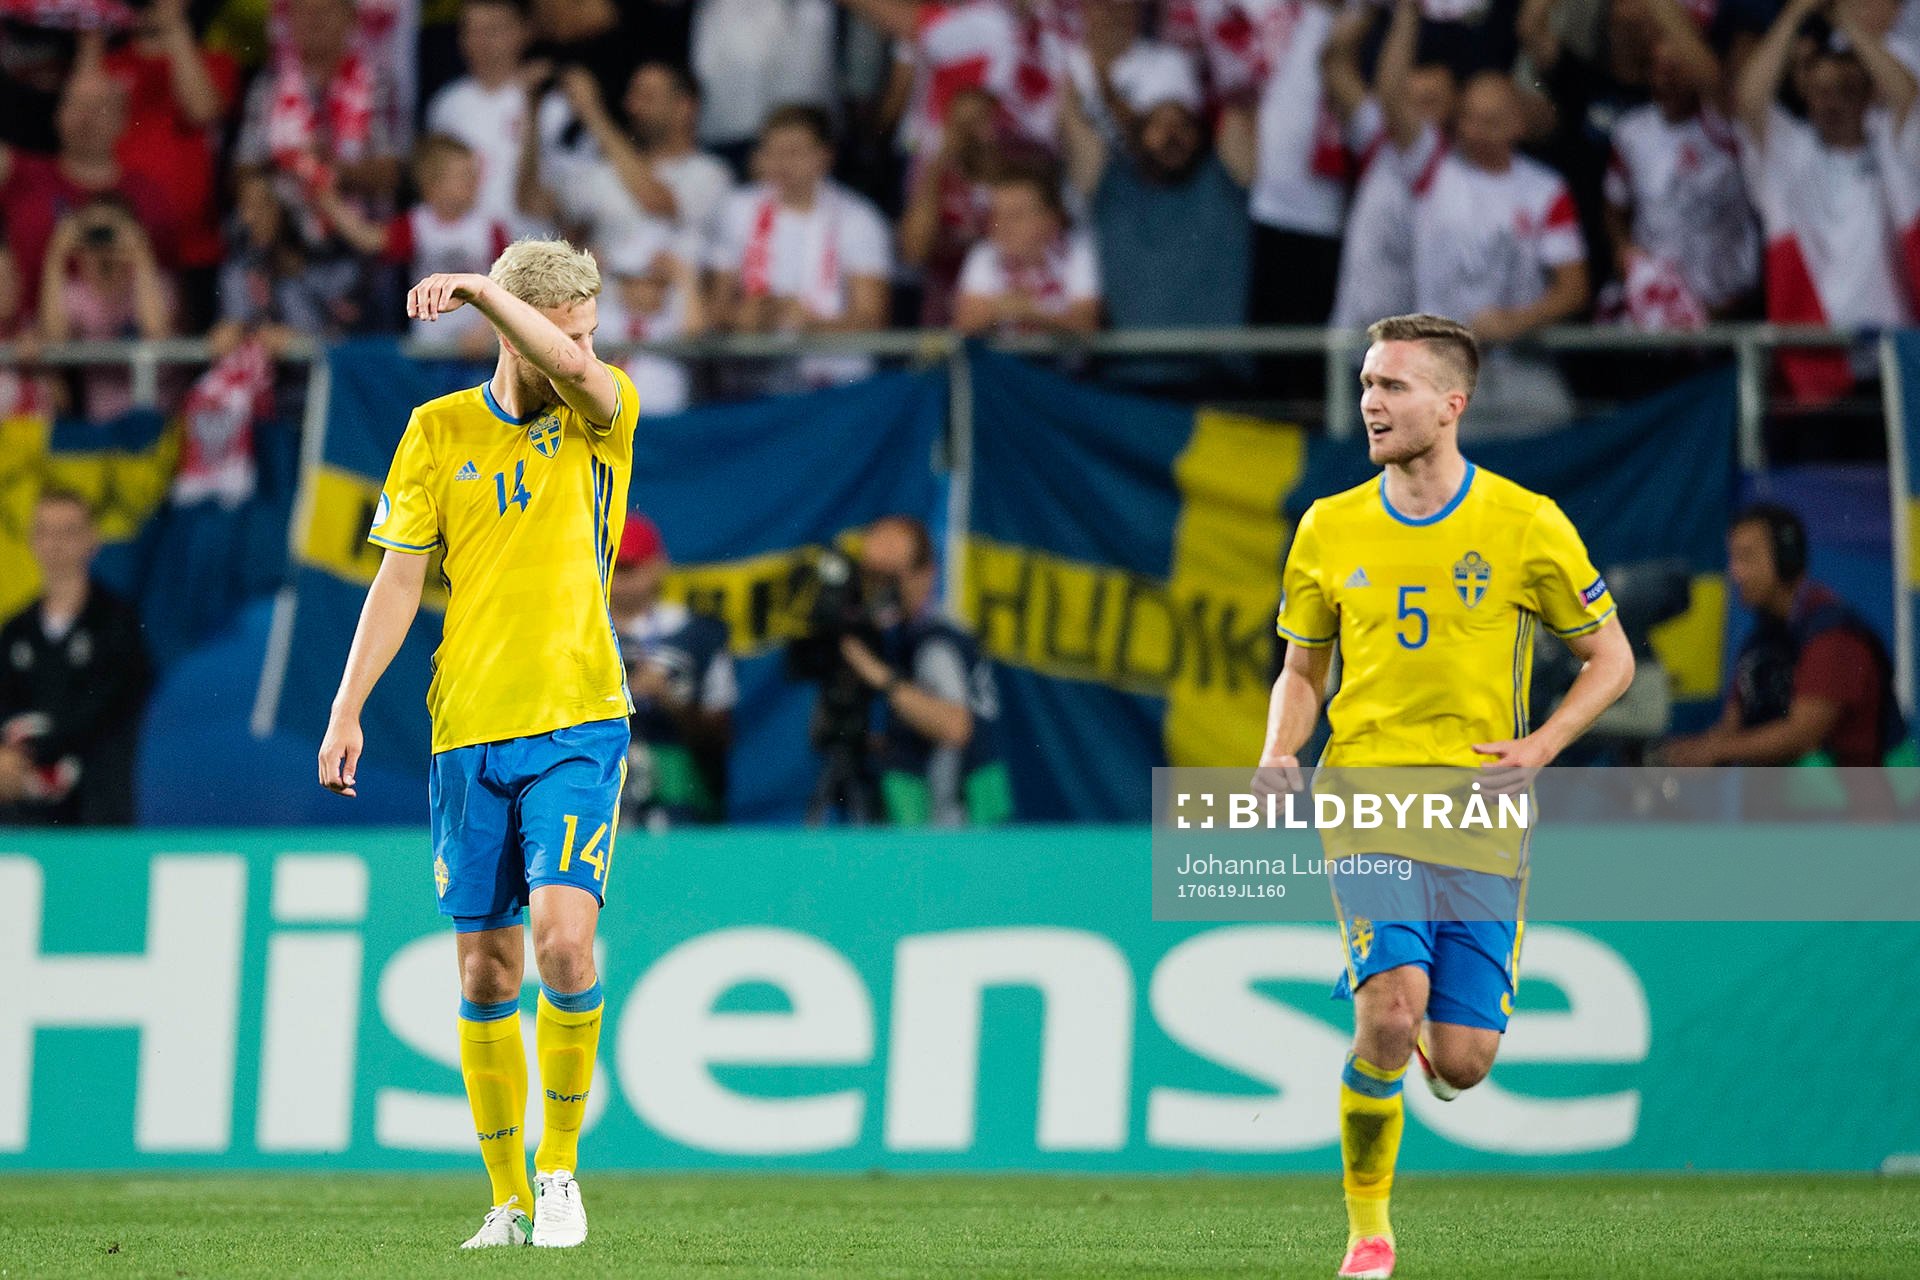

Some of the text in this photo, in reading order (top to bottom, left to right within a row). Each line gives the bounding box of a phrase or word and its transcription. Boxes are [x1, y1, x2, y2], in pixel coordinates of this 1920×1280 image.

[493, 459, 532, 517] 14
[1397, 586, 1429, 650] 5
[559, 814, 608, 881] 14
[477, 1125, 519, 1141] SvFF
